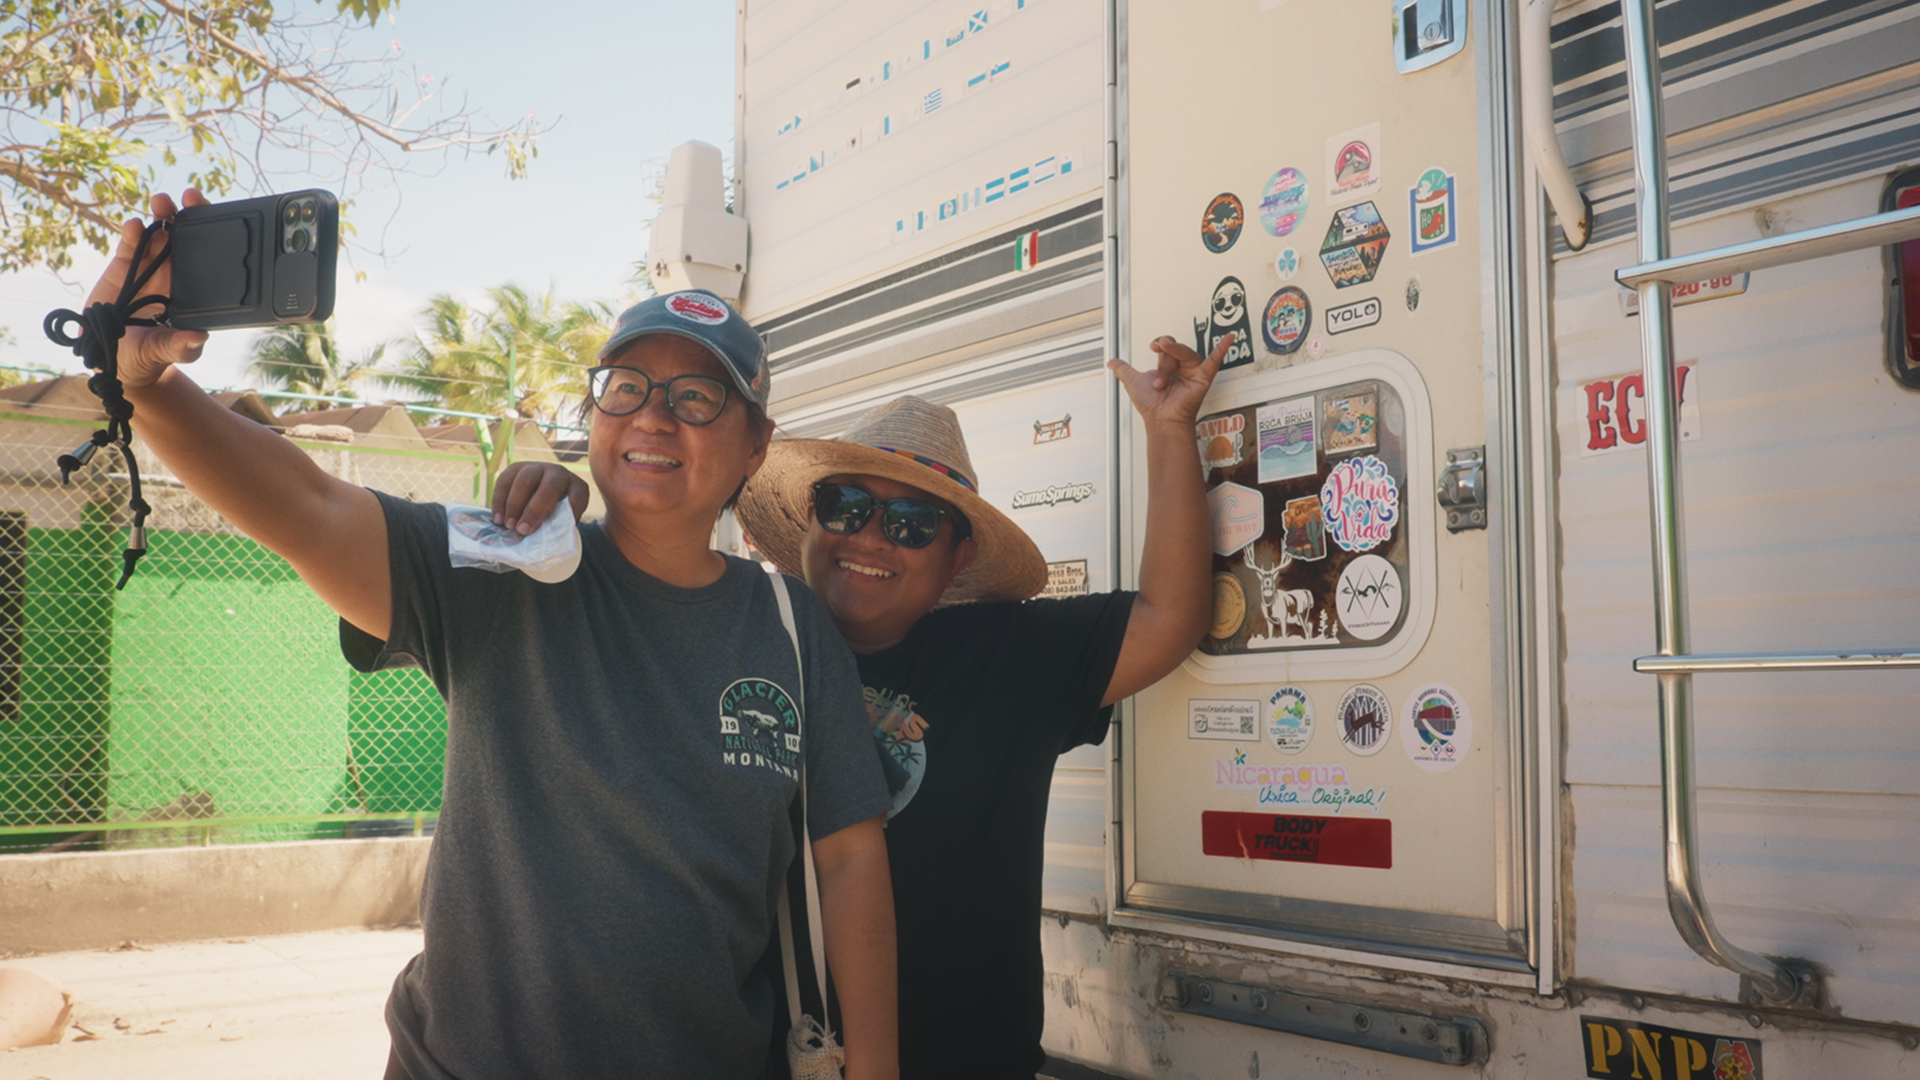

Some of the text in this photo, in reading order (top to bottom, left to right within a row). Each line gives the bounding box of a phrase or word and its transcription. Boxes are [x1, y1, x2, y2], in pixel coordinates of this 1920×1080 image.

[1330, 303, 1376, 324] YOLO
[1212, 328, 1247, 349] PRA
[1041, 423, 1064, 433] TALLER
[1200, 415, 1244, 437] WILD
[1259, 411, 1313, 430] ROCA BRUJA
[1012, 482, 1093, 509] SumoSprings
[1328, 465, 1391, 516] Pura
[1340, 505, 1389, 541] Vida
[723, 682, 796, 728] GLACIER
[725, 719, 797, 748] 19 10
[726, 735, 798, 767] NATIONAL PARK
[723, 752, 799, 783] MONTANA
[1216, 759, 1349, 793] Nicaragua
[1274, 817, 1328, 834] BODY
[1255, 834, 1314, 852] TRUCK
[1586, 1022, 1707, 1080] PNP
